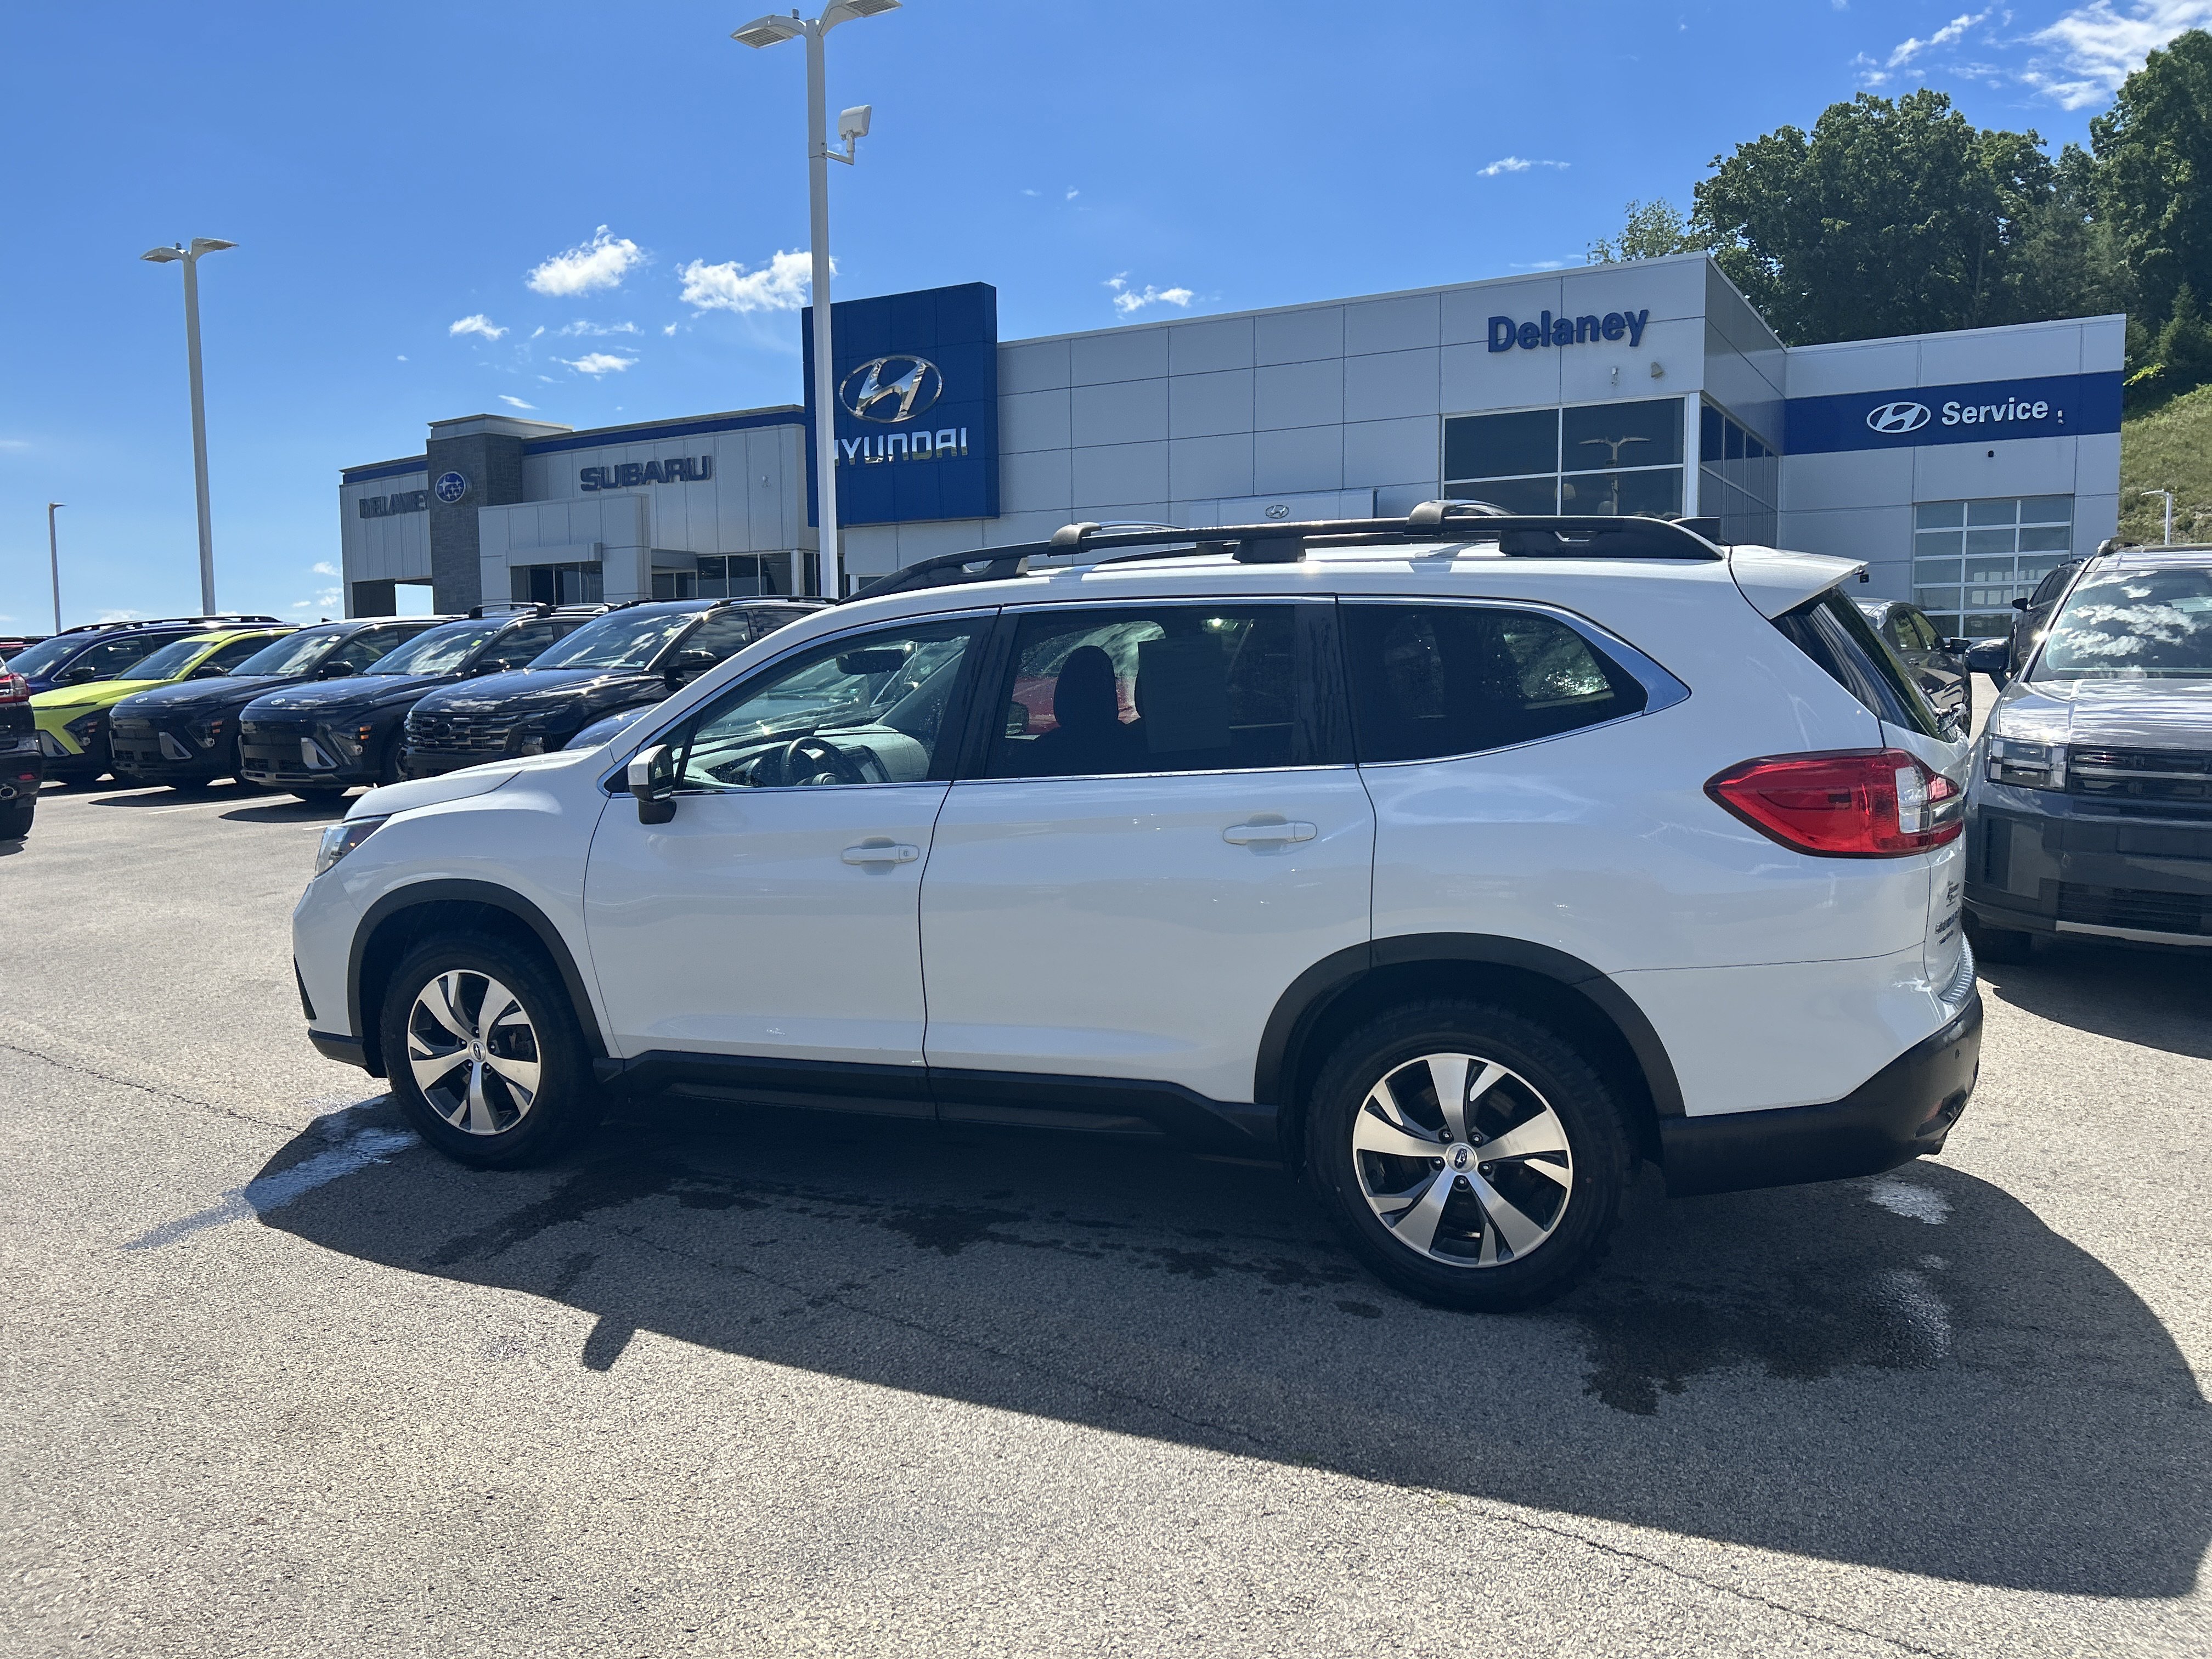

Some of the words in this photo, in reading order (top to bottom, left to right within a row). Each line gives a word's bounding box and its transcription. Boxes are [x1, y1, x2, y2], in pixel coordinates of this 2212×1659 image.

[1488, 309, 1649, 353] Delaney
[1942, 397, 2048, 426] Service
[834, 427, 968, 466] YUNDAI
[580, 456, 713, 492] SUBARU
